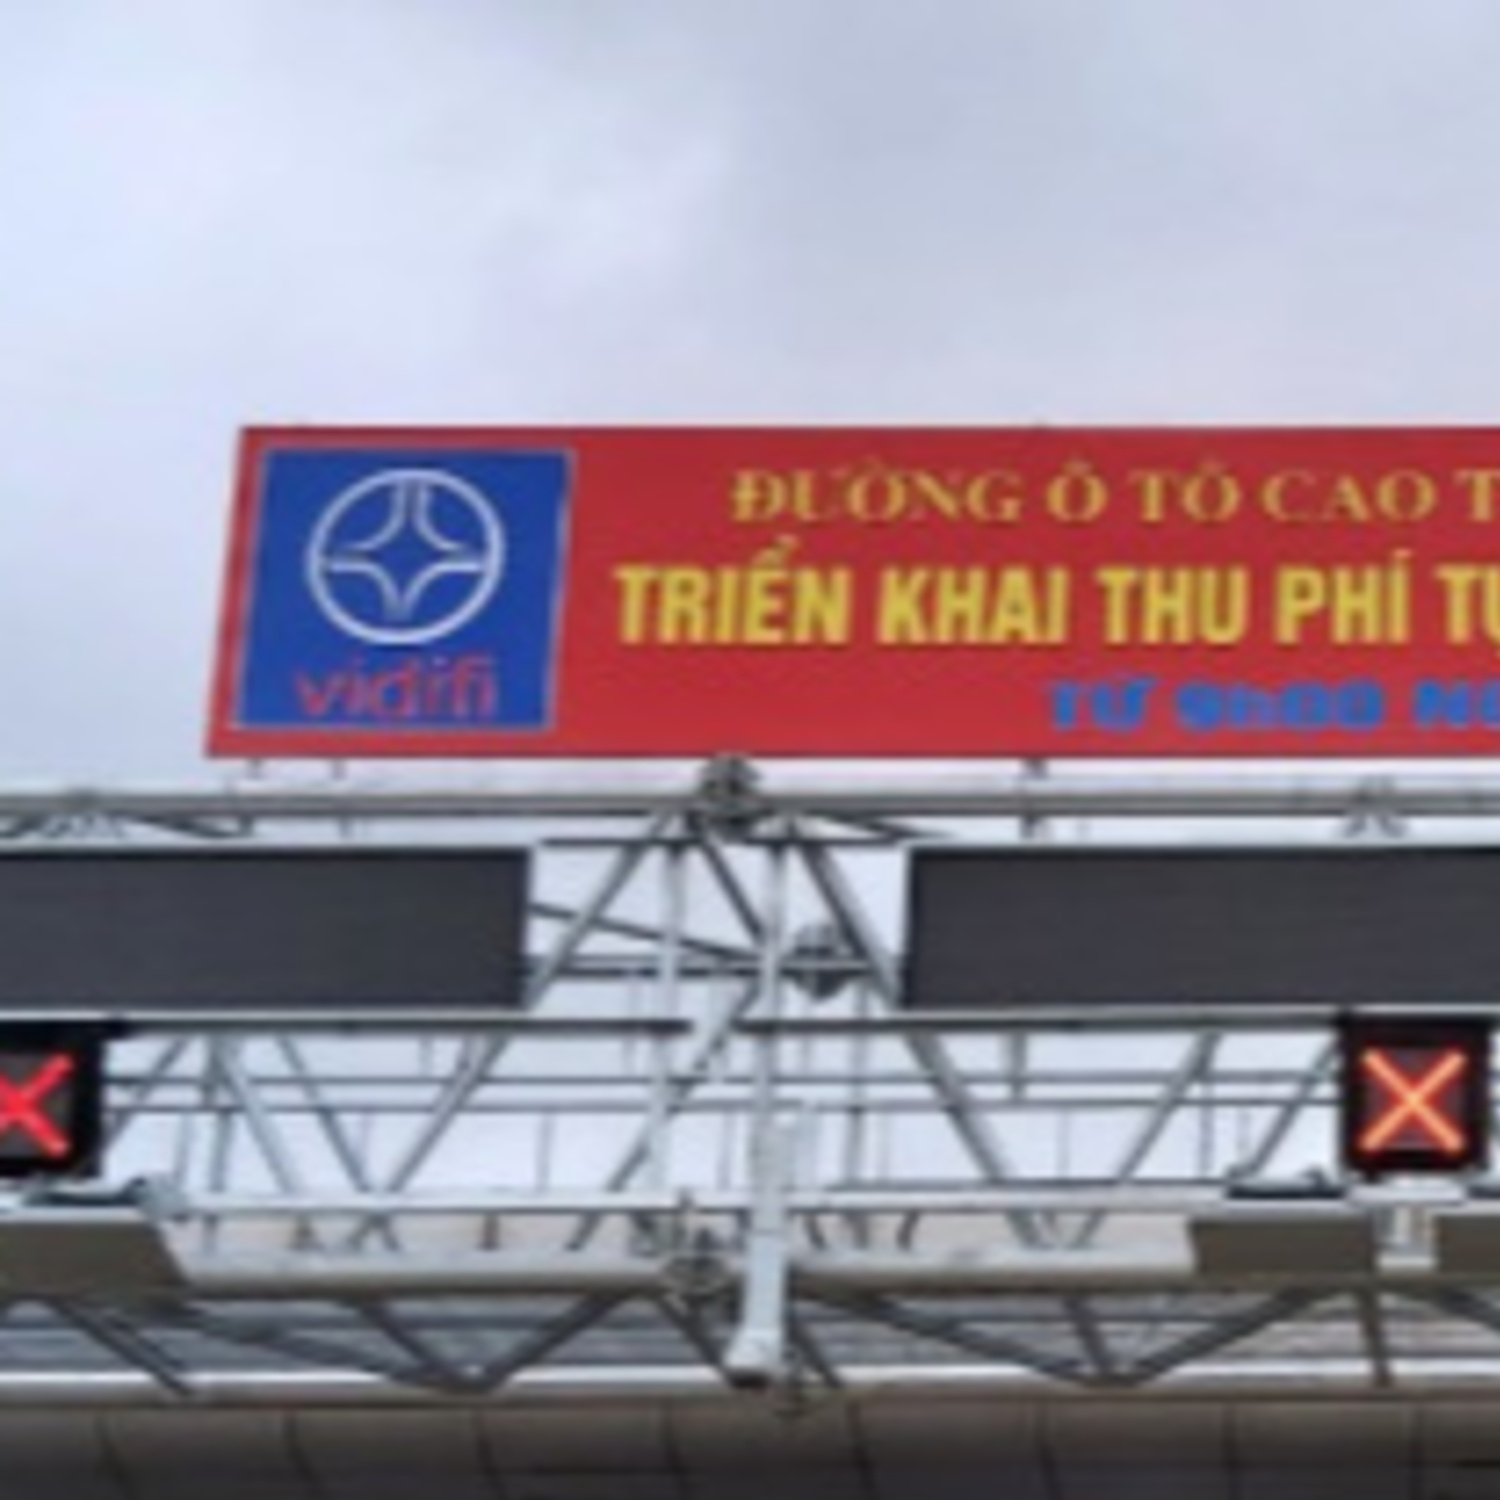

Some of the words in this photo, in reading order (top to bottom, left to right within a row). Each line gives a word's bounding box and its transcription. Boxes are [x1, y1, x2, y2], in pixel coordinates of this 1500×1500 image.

[731, 459, 1024, 525] ĐƯỜNG
[1045, 461, 1108, 523] Ô
[1132, 461, 1241, 523] TÔ
[1262, 467, 1437, 522] CAO
[614, 534, 853, 645] TRIỂN
[876, 565, 1068, 645] KHAI
[1095, 565, 1249, 645] THU
[1275, 547, 1411, 645] PHÍ
